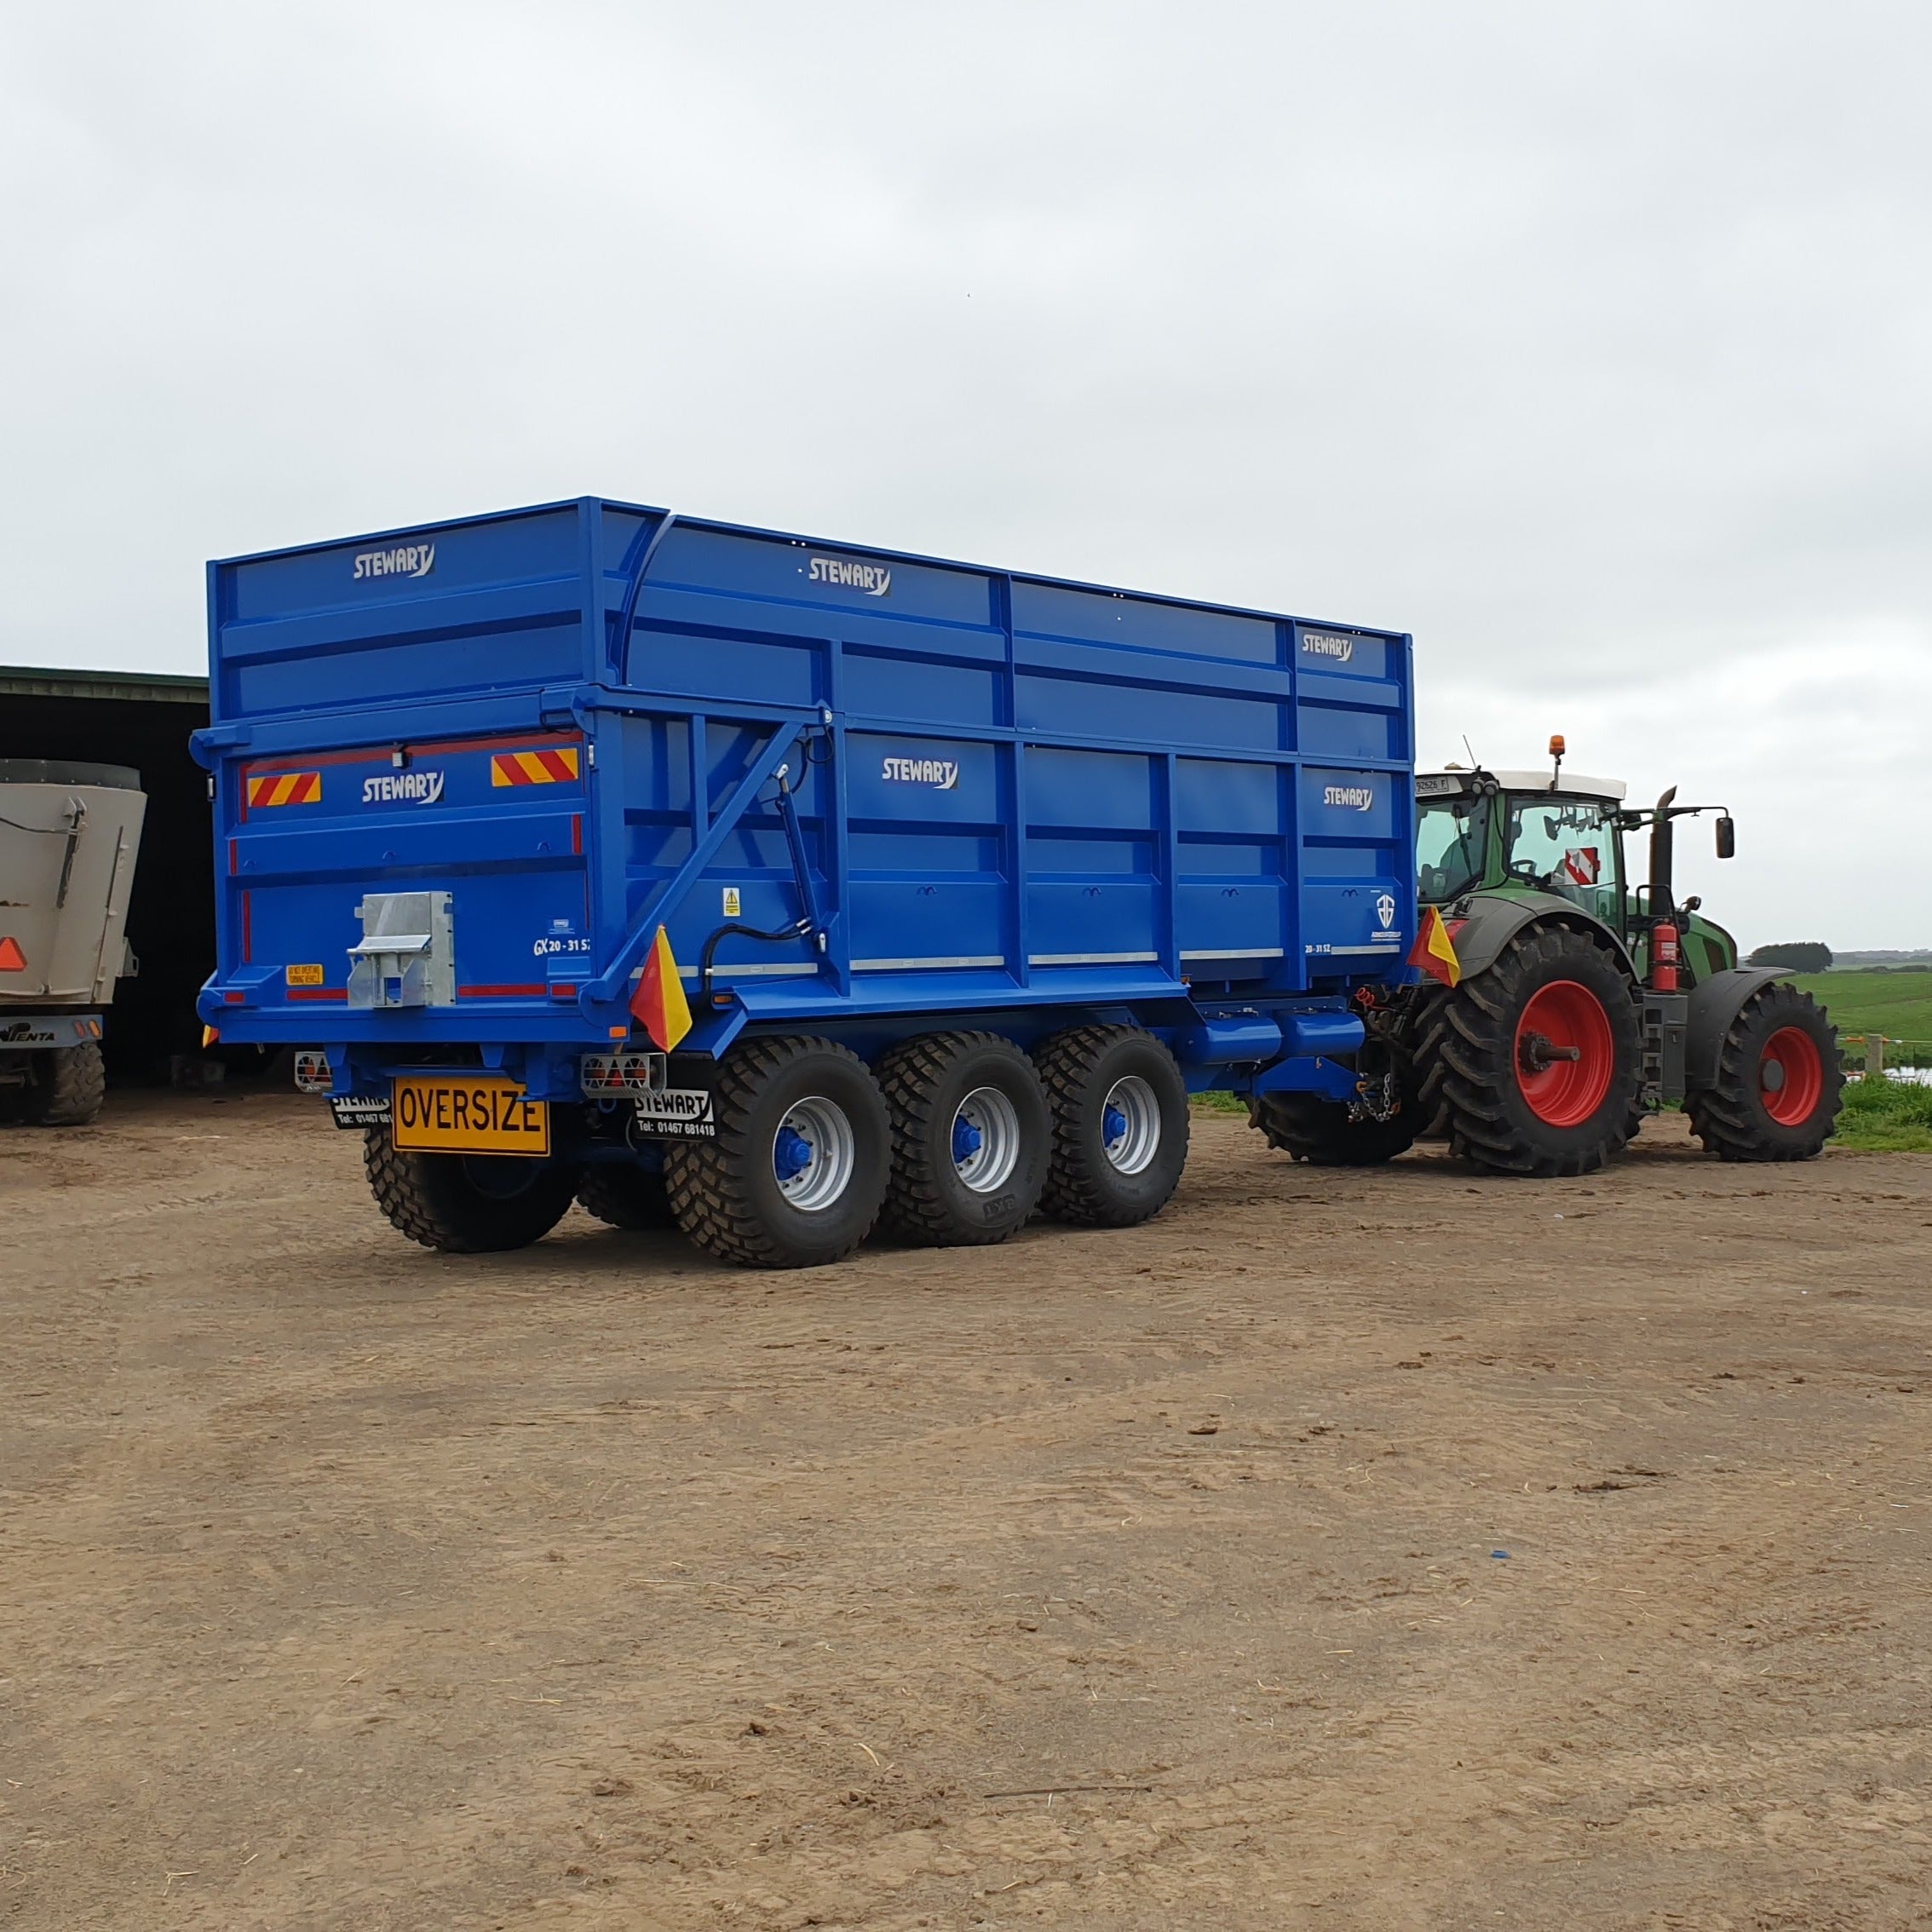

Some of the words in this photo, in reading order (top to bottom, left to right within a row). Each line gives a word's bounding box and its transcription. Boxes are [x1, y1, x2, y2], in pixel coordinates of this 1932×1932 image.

[354, 543, 434, 578] STEWART
[808, 558, 890, 596] STEWART
[1302, 634, 1352, 662] STEWART
[362, 770, 444, 804] STEWART
[882, 758, 957, 789] STEWART
[1324, 786, 1372, 811] STEWART
[400, 1087, 541, 1132] OVERSIZE
[637, 1120, 654, 1132] Tel:
[658, 1122, 682, 1134] 01467
[684, 1123, 715, 1136] 681418
